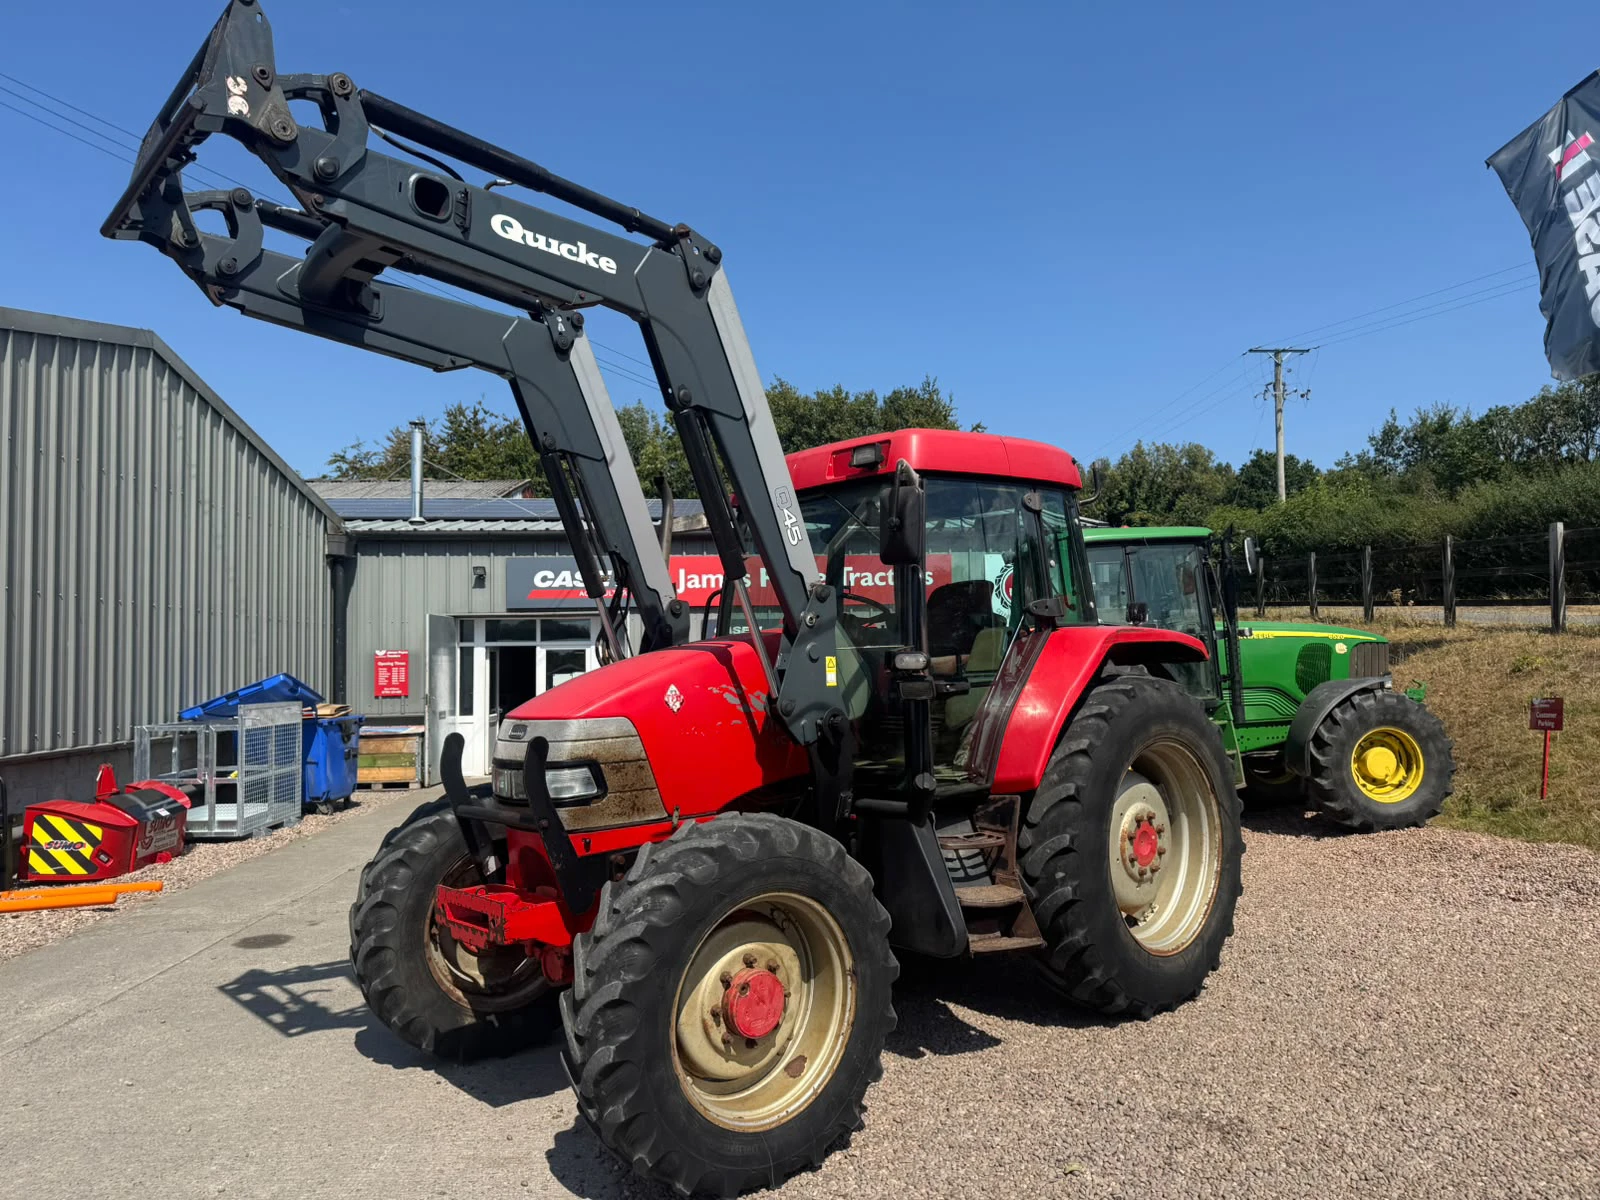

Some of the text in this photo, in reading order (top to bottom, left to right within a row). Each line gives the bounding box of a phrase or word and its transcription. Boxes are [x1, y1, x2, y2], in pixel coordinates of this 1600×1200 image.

[490, 213, 617, 275] Quicke
[676, 567, 751, 594] Jams
[843, 566, 934, 586] Tracts
[45, 840, 85, 851] SUMO
